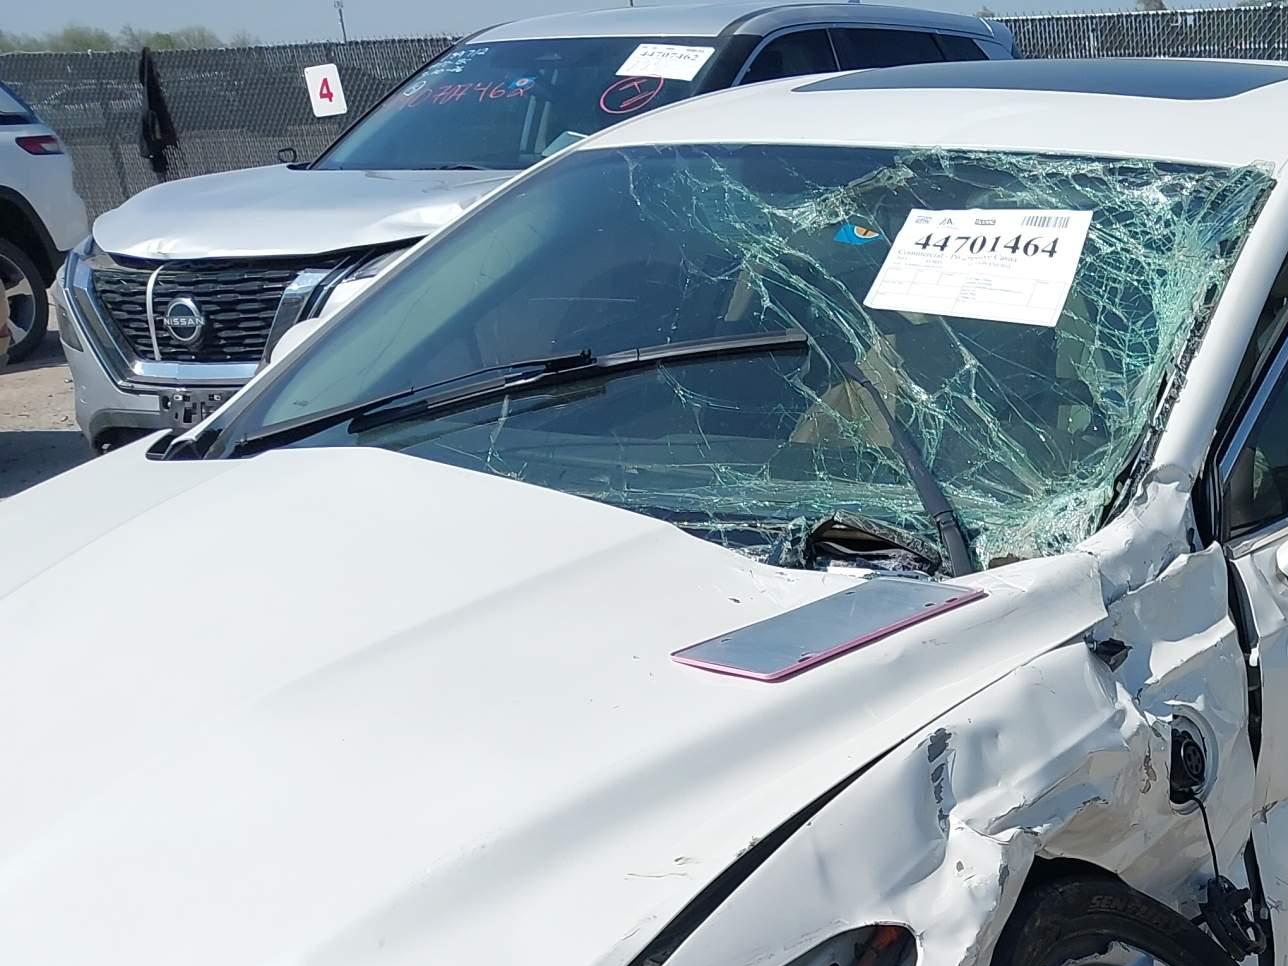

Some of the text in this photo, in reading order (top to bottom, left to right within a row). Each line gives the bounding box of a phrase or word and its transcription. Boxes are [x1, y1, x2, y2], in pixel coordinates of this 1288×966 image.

[319, 77, 334, 103] 4
[914, 232, 1060, 258] 44701464
[163, 316, 205, 326] NISSAN
